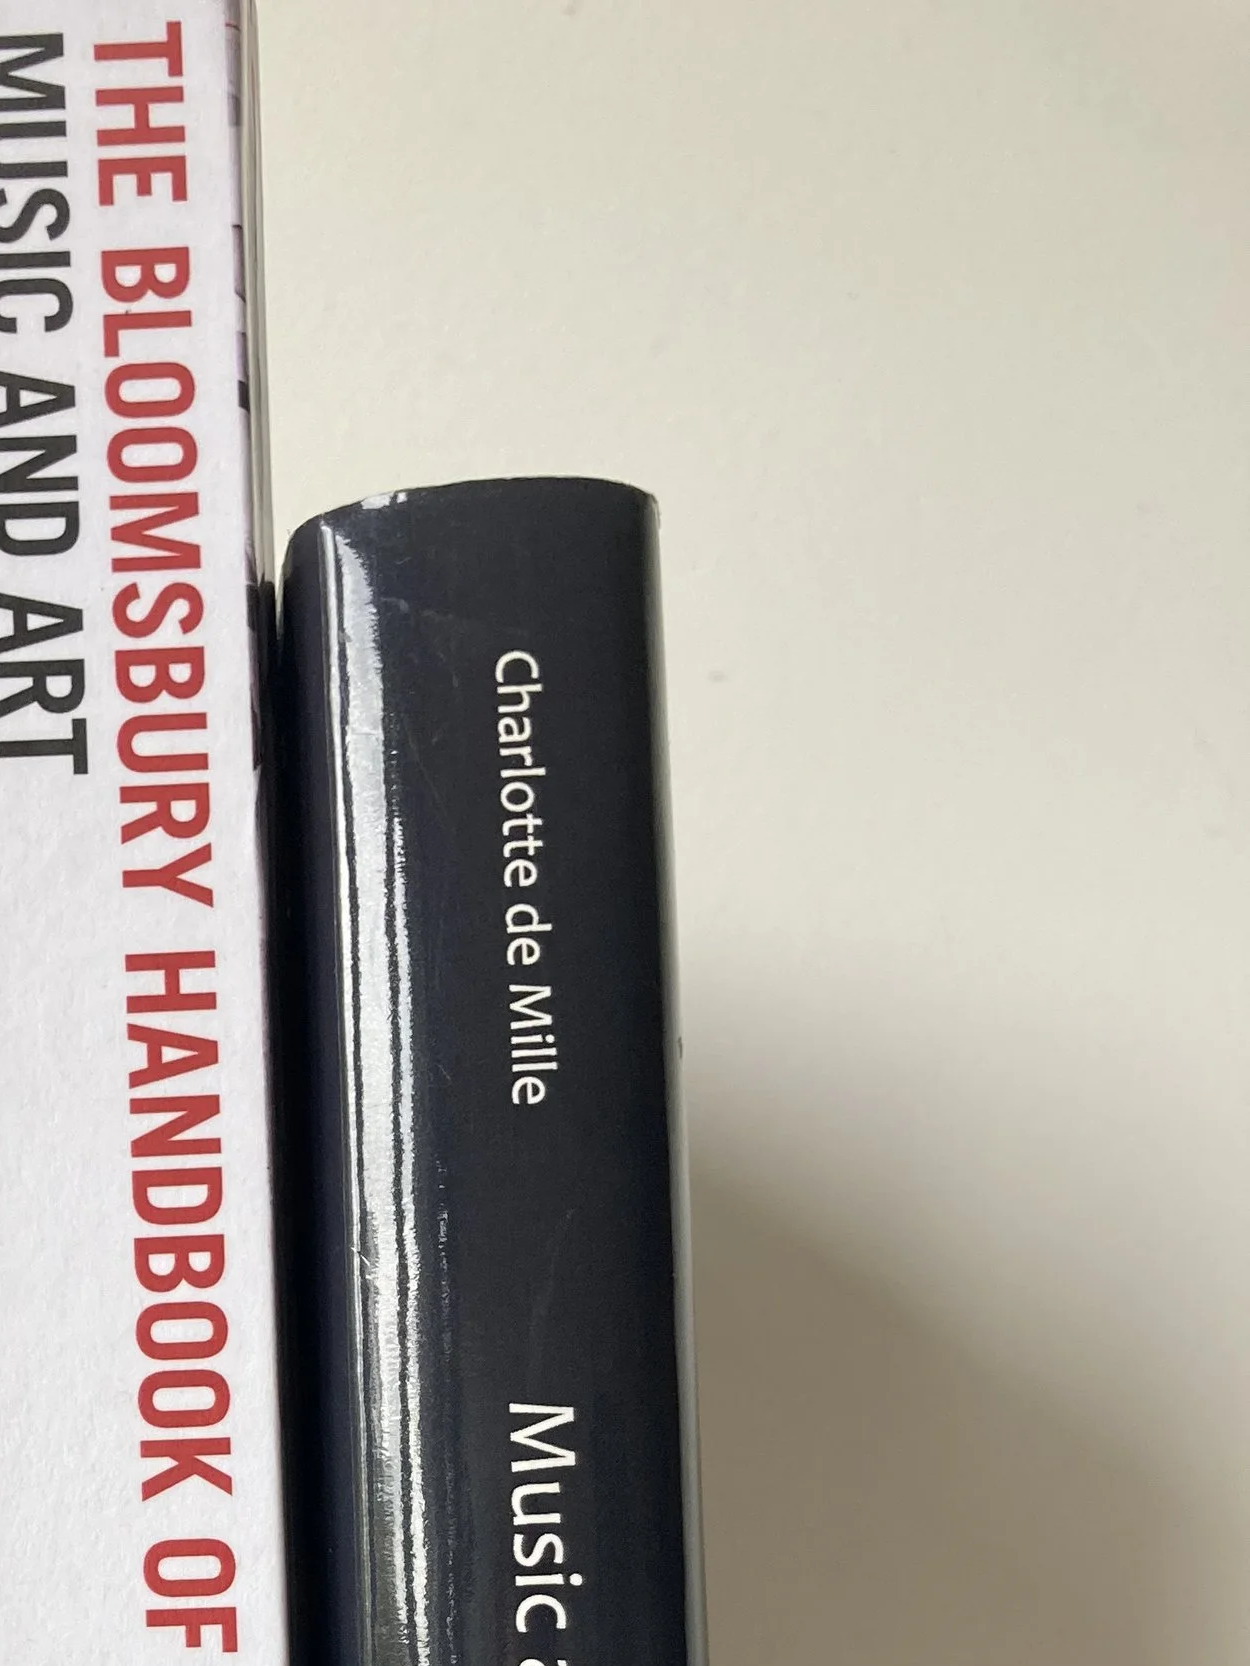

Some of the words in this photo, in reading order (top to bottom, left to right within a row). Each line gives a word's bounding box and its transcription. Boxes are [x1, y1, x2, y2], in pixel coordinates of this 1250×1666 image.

[93, 20, 188, 207] THE
[100, 245, 214, 907] BLOOMSBURY
[495, 650, 546, 888] Charlotte
[505, 903, 553, 966] de
[508, 984, 558, 1105] Mille
[124, 950, 233, 1501] HANDBOOK
[142, 1538, 239, 1654] OF
[508, 1402, 583, 1633] Music
